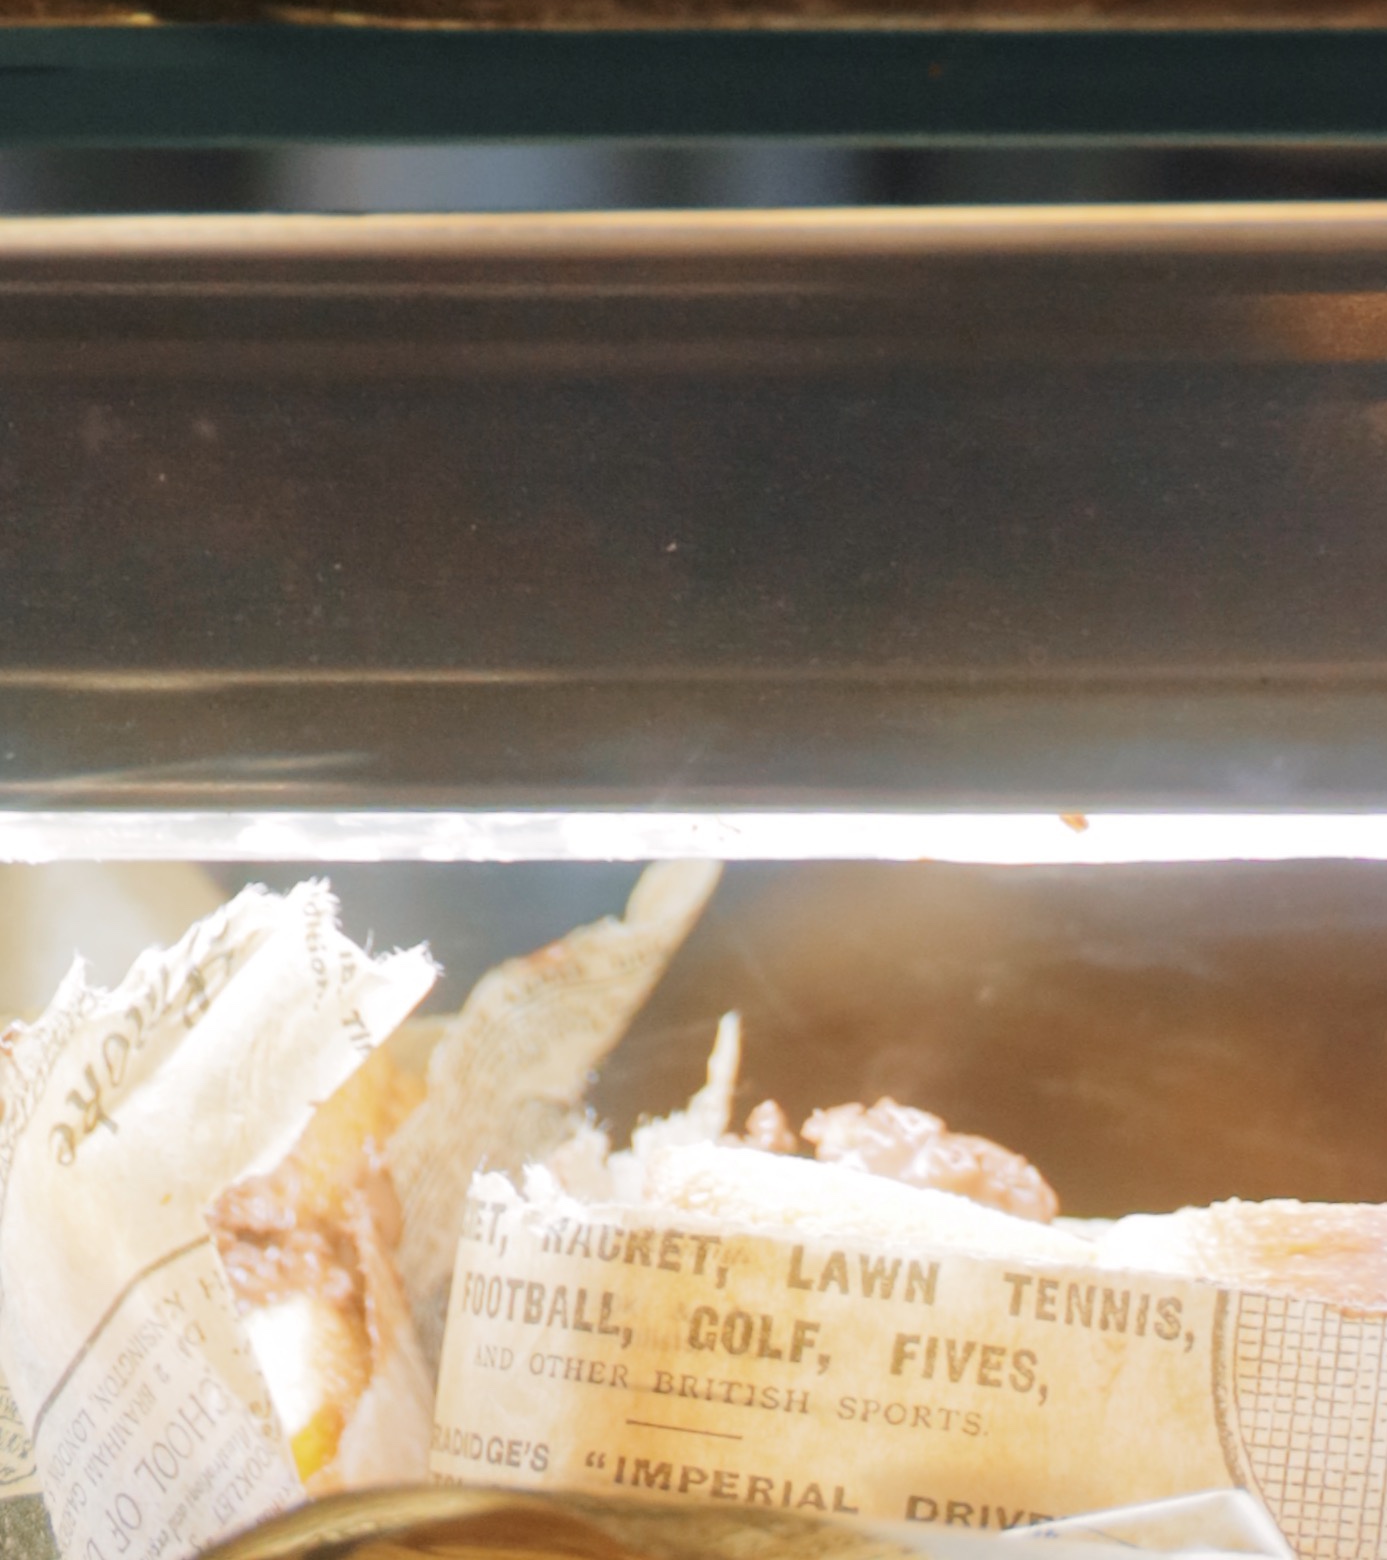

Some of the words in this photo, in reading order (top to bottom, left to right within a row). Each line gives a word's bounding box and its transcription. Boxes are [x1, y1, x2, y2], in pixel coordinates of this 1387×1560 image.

[460, 1271, 633, 1349] FOOTBALL,
[687, 1305, 832, 1375] GOLF,
[889, 1331, 1049, 1407] FIVES,
[786, 1245, 941, 1306] LAWN
[1003, 1271, 1196, 1353] TENNIS,
[134, 1366, 232, 1494] CHOOL
[474, 1344, 514, 1371] AND
[529, 1353, 630, 1389] OTHER
[652, 1370, 810, 1415] BRITISH
[836, 1395, 990, 1438] SPORTS.
[104, 1492, 143, 1555] OF
